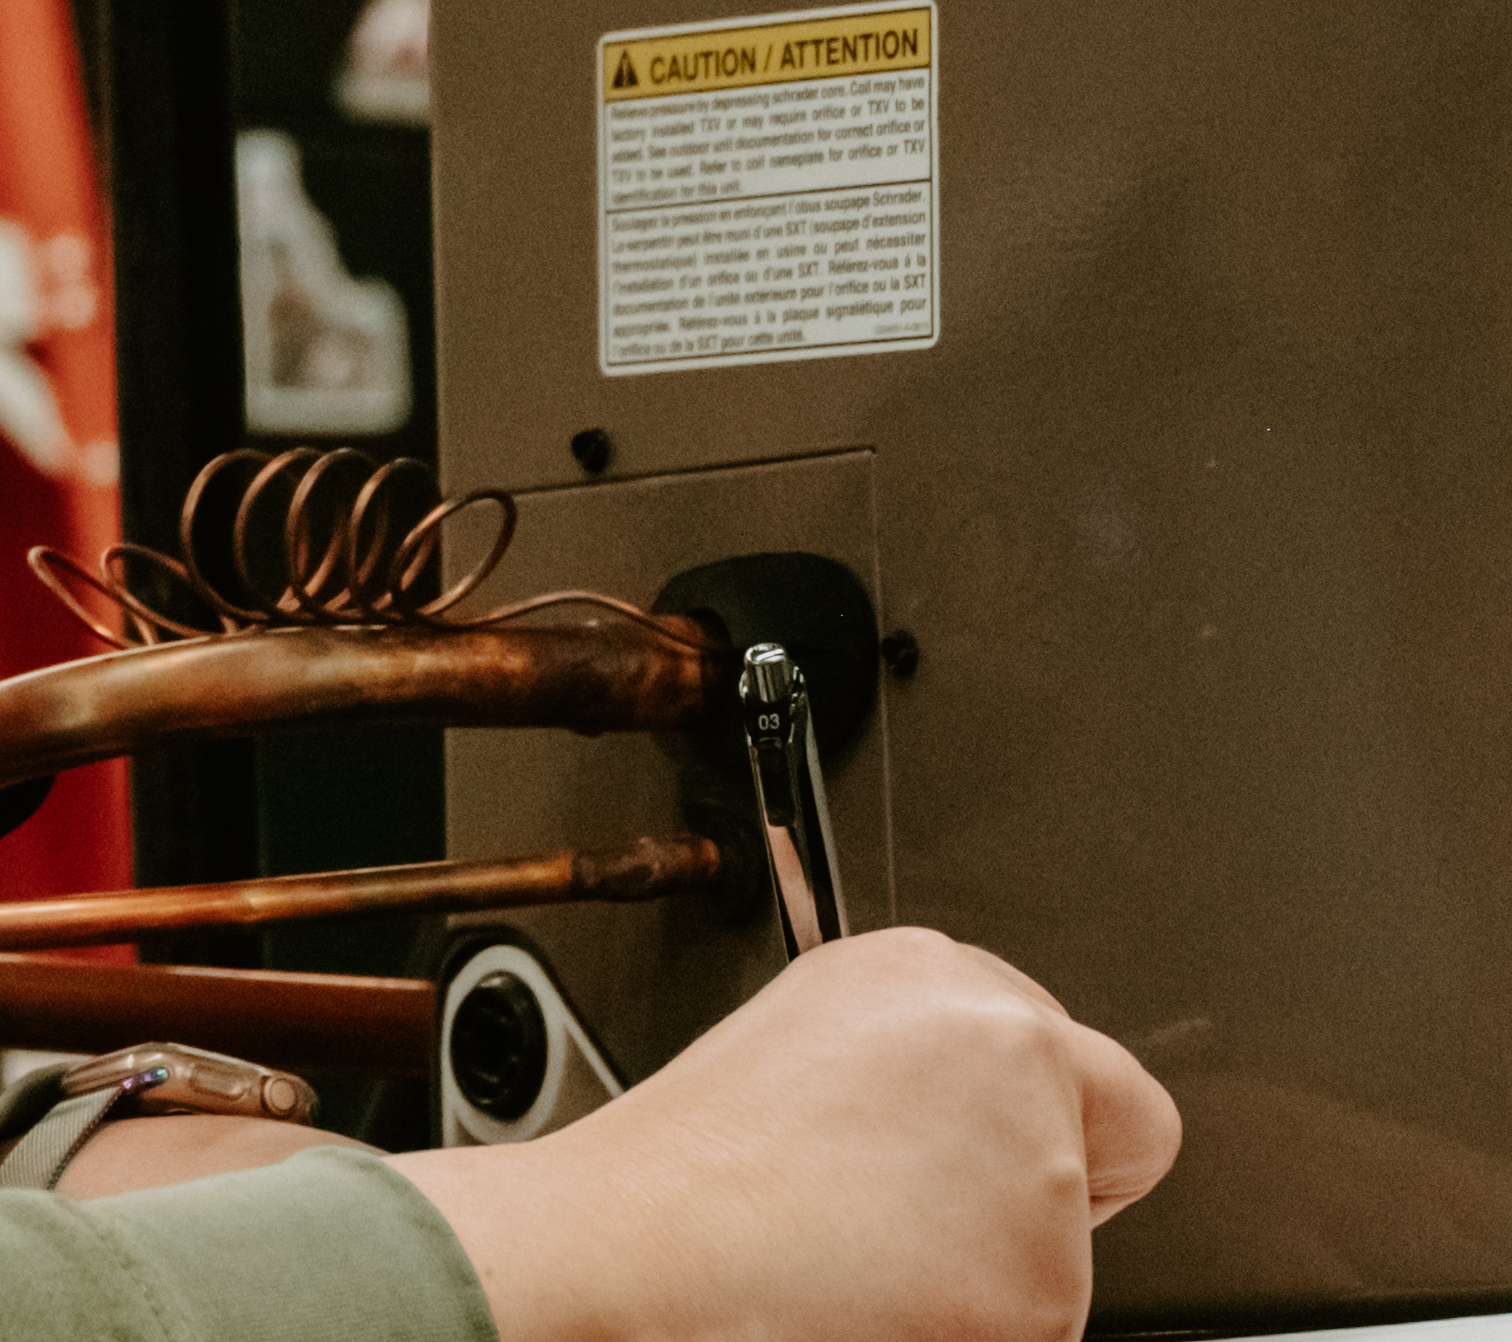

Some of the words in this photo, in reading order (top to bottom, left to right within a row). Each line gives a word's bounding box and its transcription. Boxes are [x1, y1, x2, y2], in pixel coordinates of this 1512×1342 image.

[650, 45, 756, 84] CAUTION
[763, 43, 772, 72] /
[780, 28, 918, 70] ATTENTION
[850, 80, 871, 96] Coil
[872, 80, 895, 97] may
[897, 74, 925, 90] have
[850, 106, 861, 117] or
[867, 98, 889, 115] TXV
[894, 97, 906, 113] to
[911, 95, 924, 111] be
[875, 119, 911, 135] orifice
[913, 120, 924, 132] or
[847, 142, 882, 159] orifice
[886, 143, 898, 155] or
[903, 137, 925, 154] TXV
[903, 272, 926, 289] SXT
